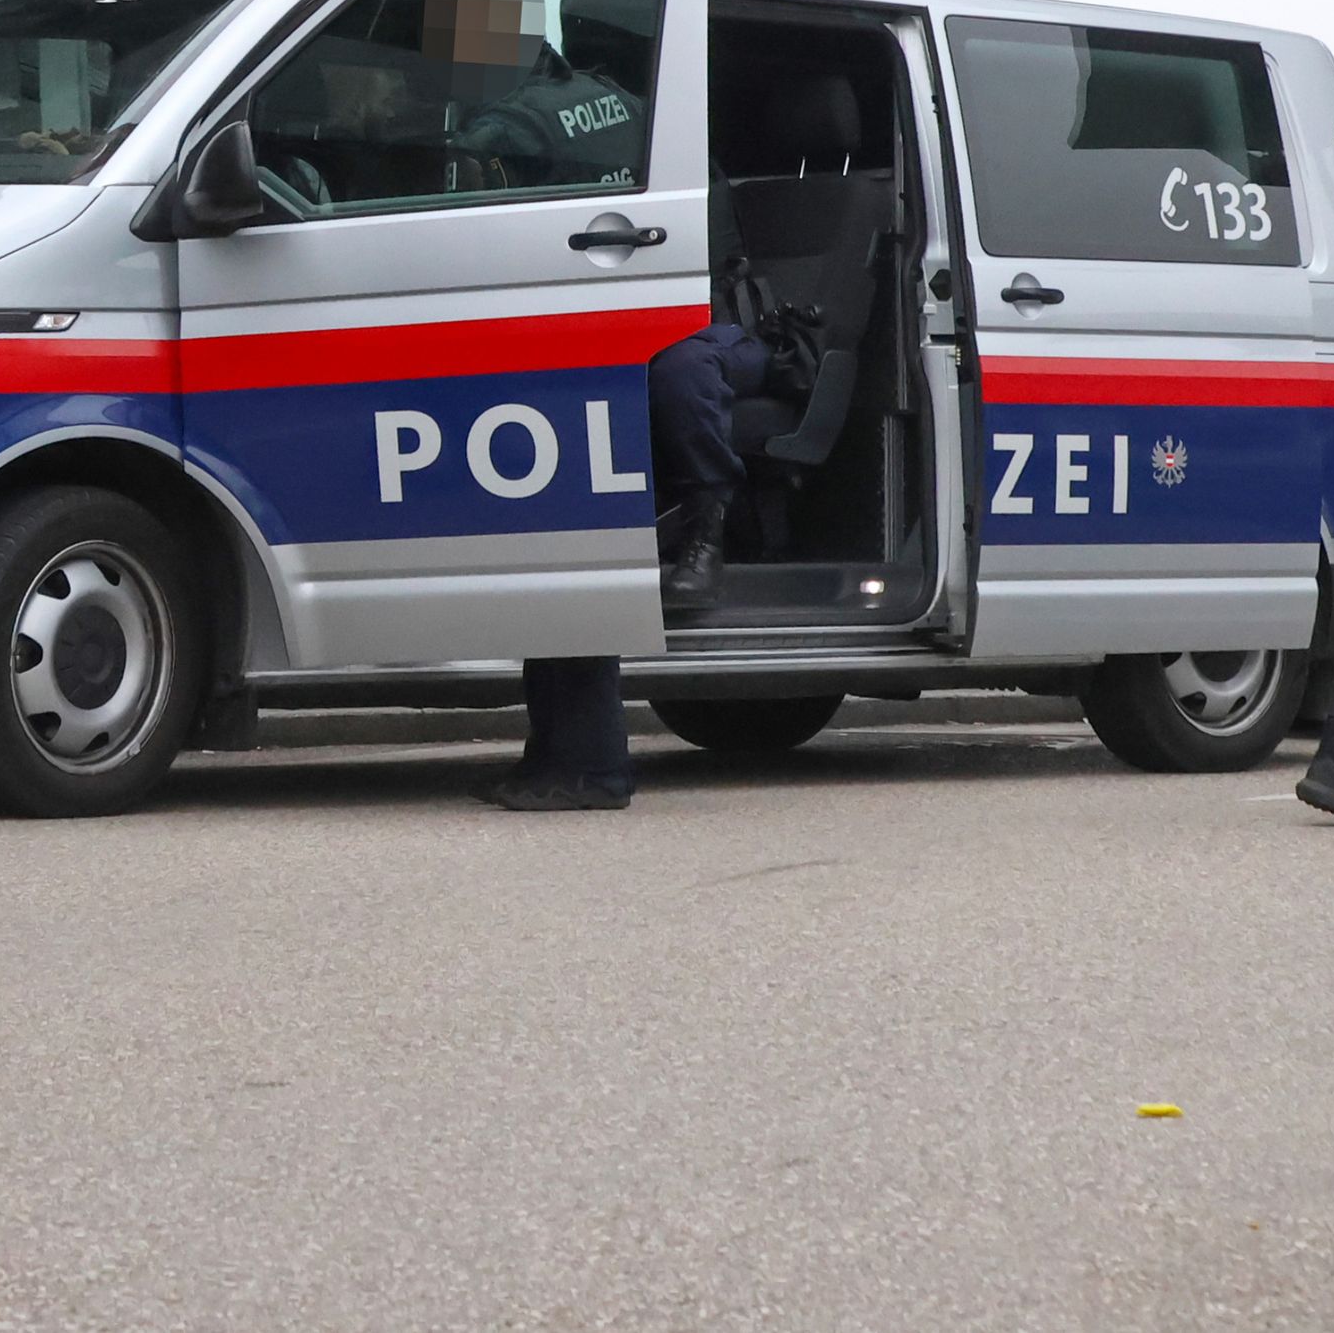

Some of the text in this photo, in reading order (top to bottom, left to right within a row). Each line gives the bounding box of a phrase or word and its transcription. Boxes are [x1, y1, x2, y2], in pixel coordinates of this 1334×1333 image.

[558, 94, 630, 138] POLIZEI
[1193, 181, 1273, 242] 133
[374, 399, 1129, 515] POL ZEI
